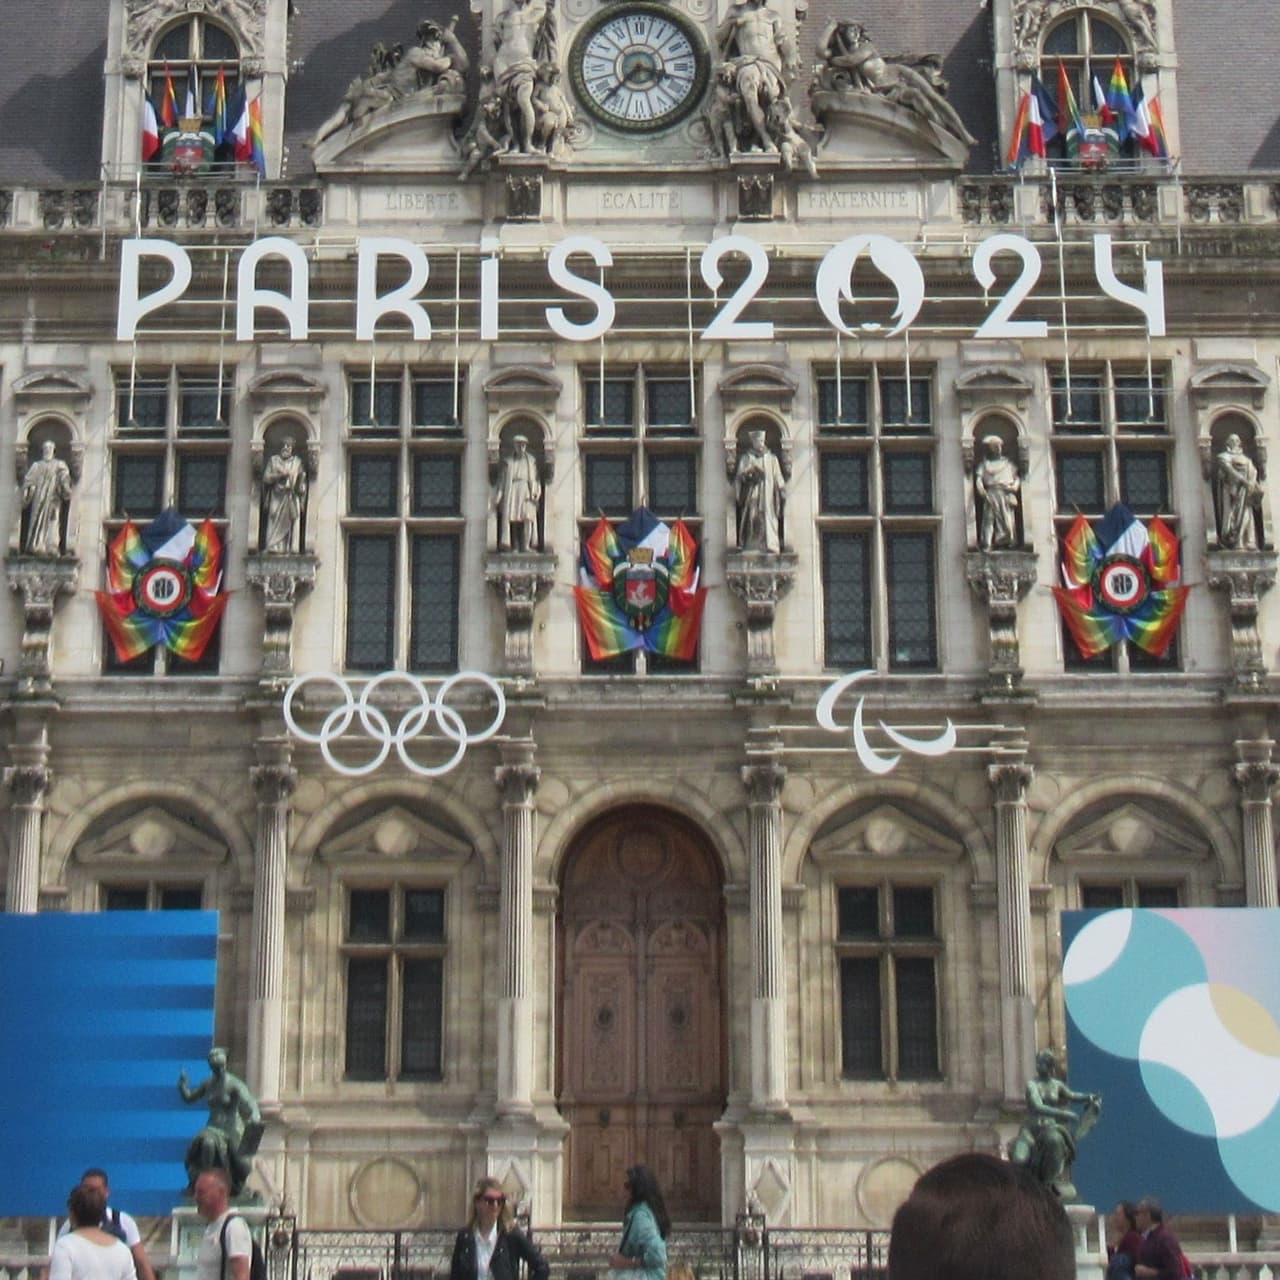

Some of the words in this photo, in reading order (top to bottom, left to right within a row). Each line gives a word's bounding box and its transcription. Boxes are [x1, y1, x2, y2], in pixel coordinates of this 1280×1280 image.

[383, 189, 459, 209] LIBERTÉ
[602, 190, 680, 208] ÉGALITÉ
[700, 233, 1166, 339] 2024
